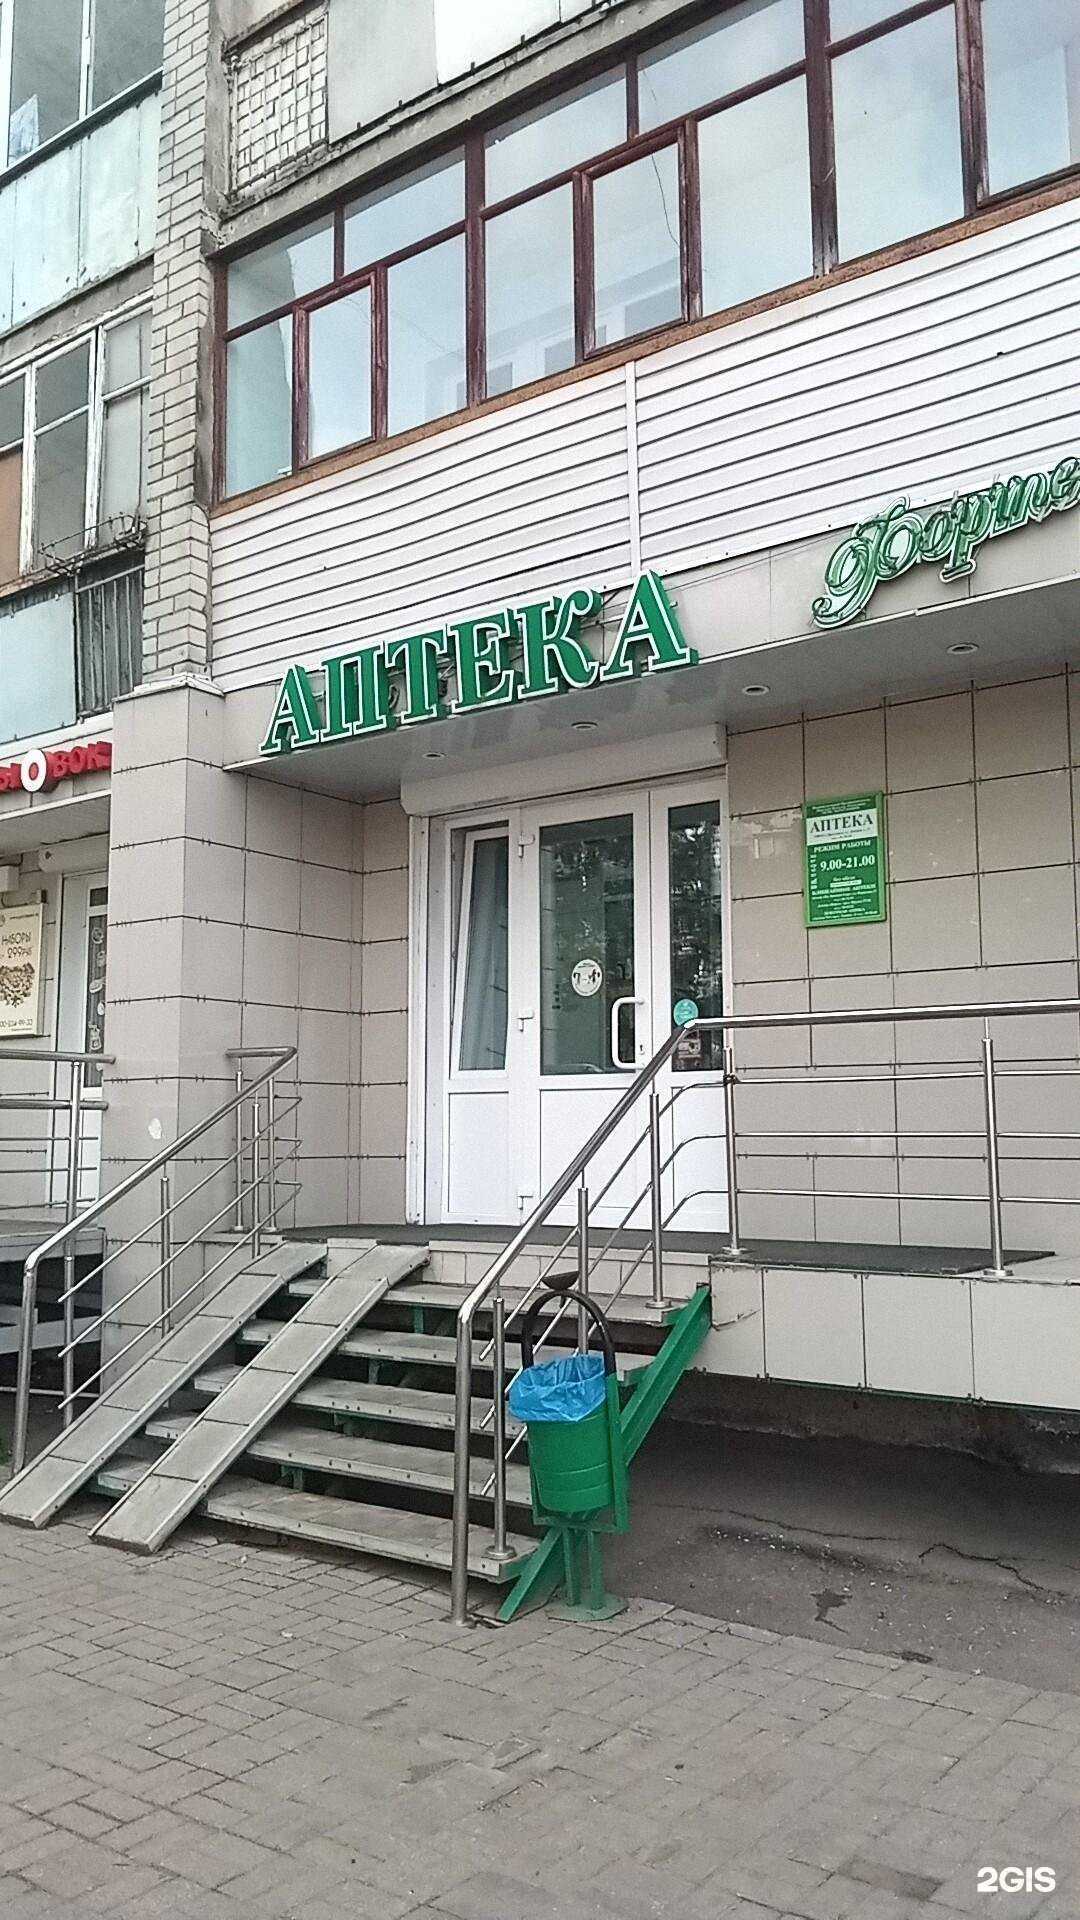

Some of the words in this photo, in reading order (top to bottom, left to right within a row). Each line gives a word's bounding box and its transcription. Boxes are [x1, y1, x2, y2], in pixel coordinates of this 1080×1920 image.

[259, 569, 698, 757] АПТЕКА
[811, 813, 873, 833] АПТЕКА
[813, 843, 840, 853] РЕЖИМ
[841, 839, 871, 850] РАБОТЫ
[820, 854, 875, 871] 9.00-21.00
